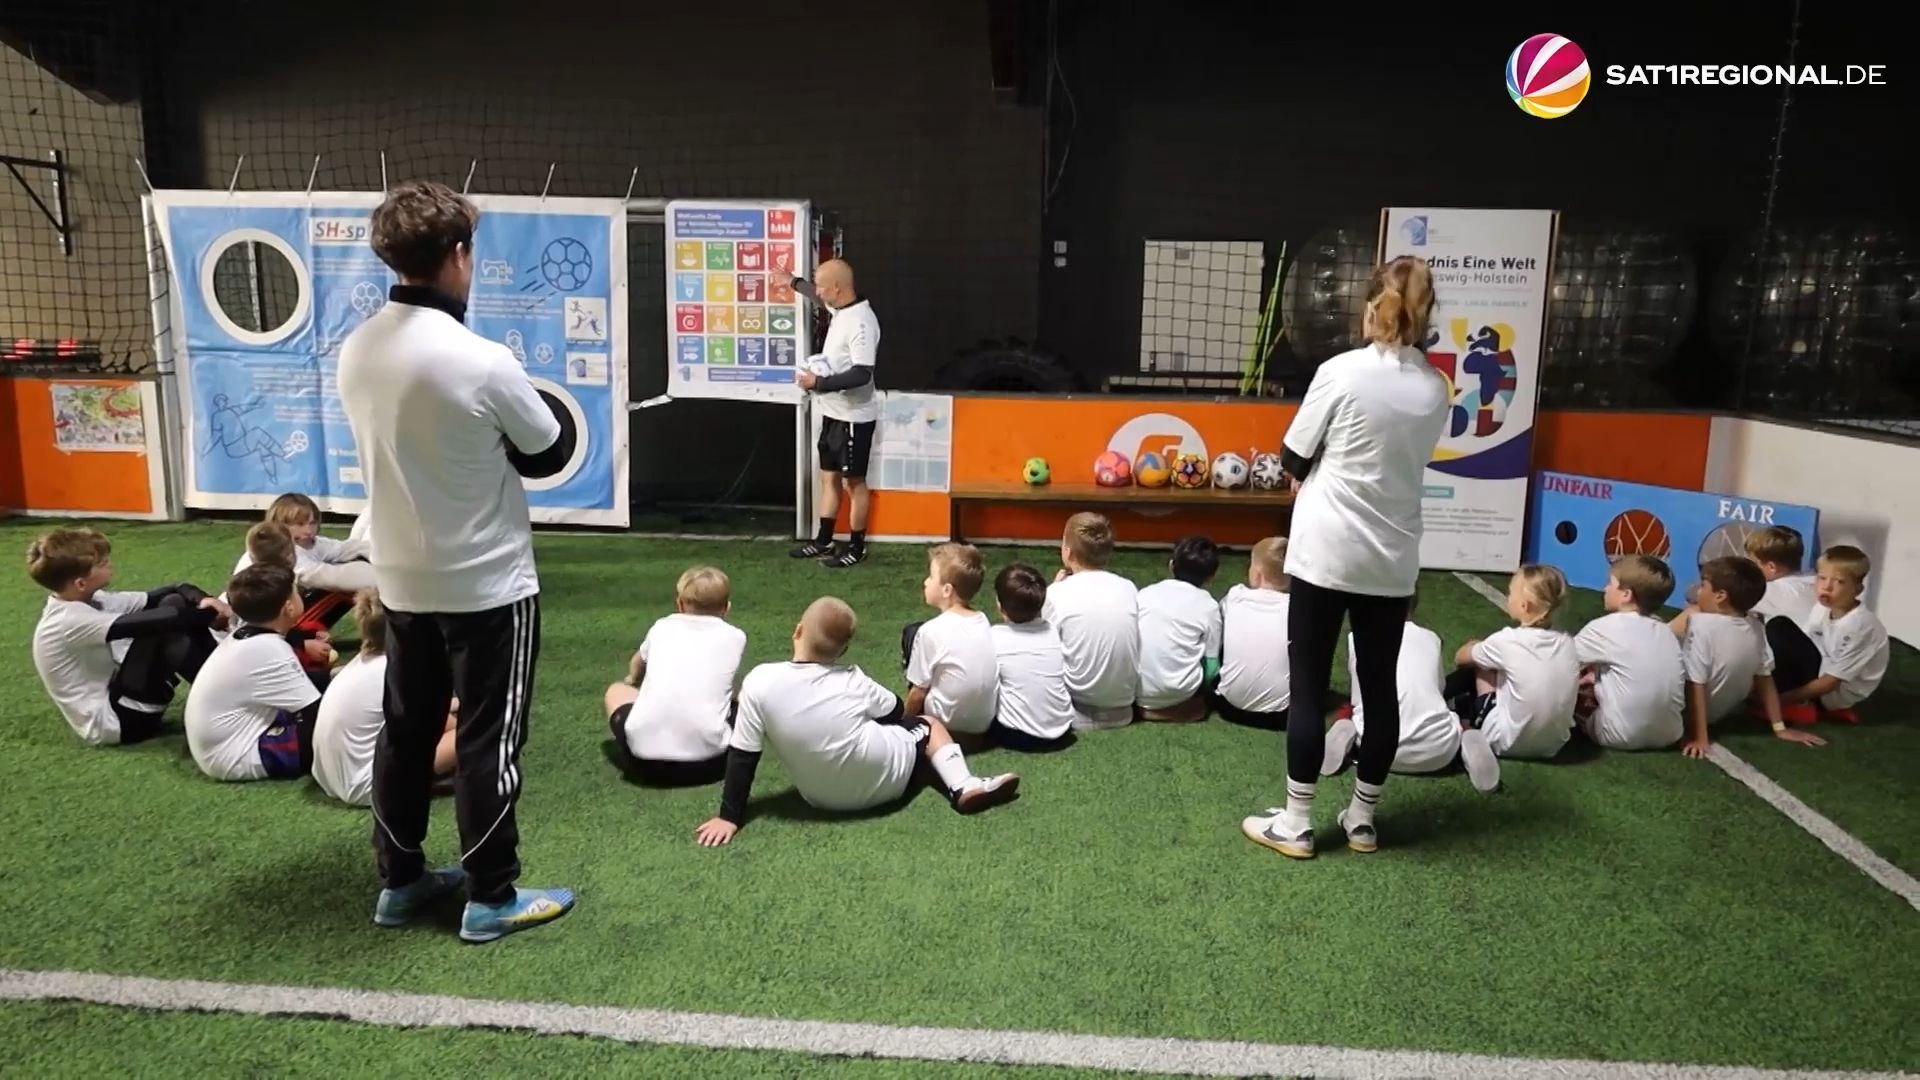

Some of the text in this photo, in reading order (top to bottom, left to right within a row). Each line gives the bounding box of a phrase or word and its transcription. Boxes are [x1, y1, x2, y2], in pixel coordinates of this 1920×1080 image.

[314, 221, 370, 241] SH-sp
[1426, 255, 1536, 270] dnis Eine Welt
[1434, 272, 1528, 286] swig-Holstein
[1542, 474, 1612, 500] UNFAIR
[1718, 499, 1775, 526] FAIR
